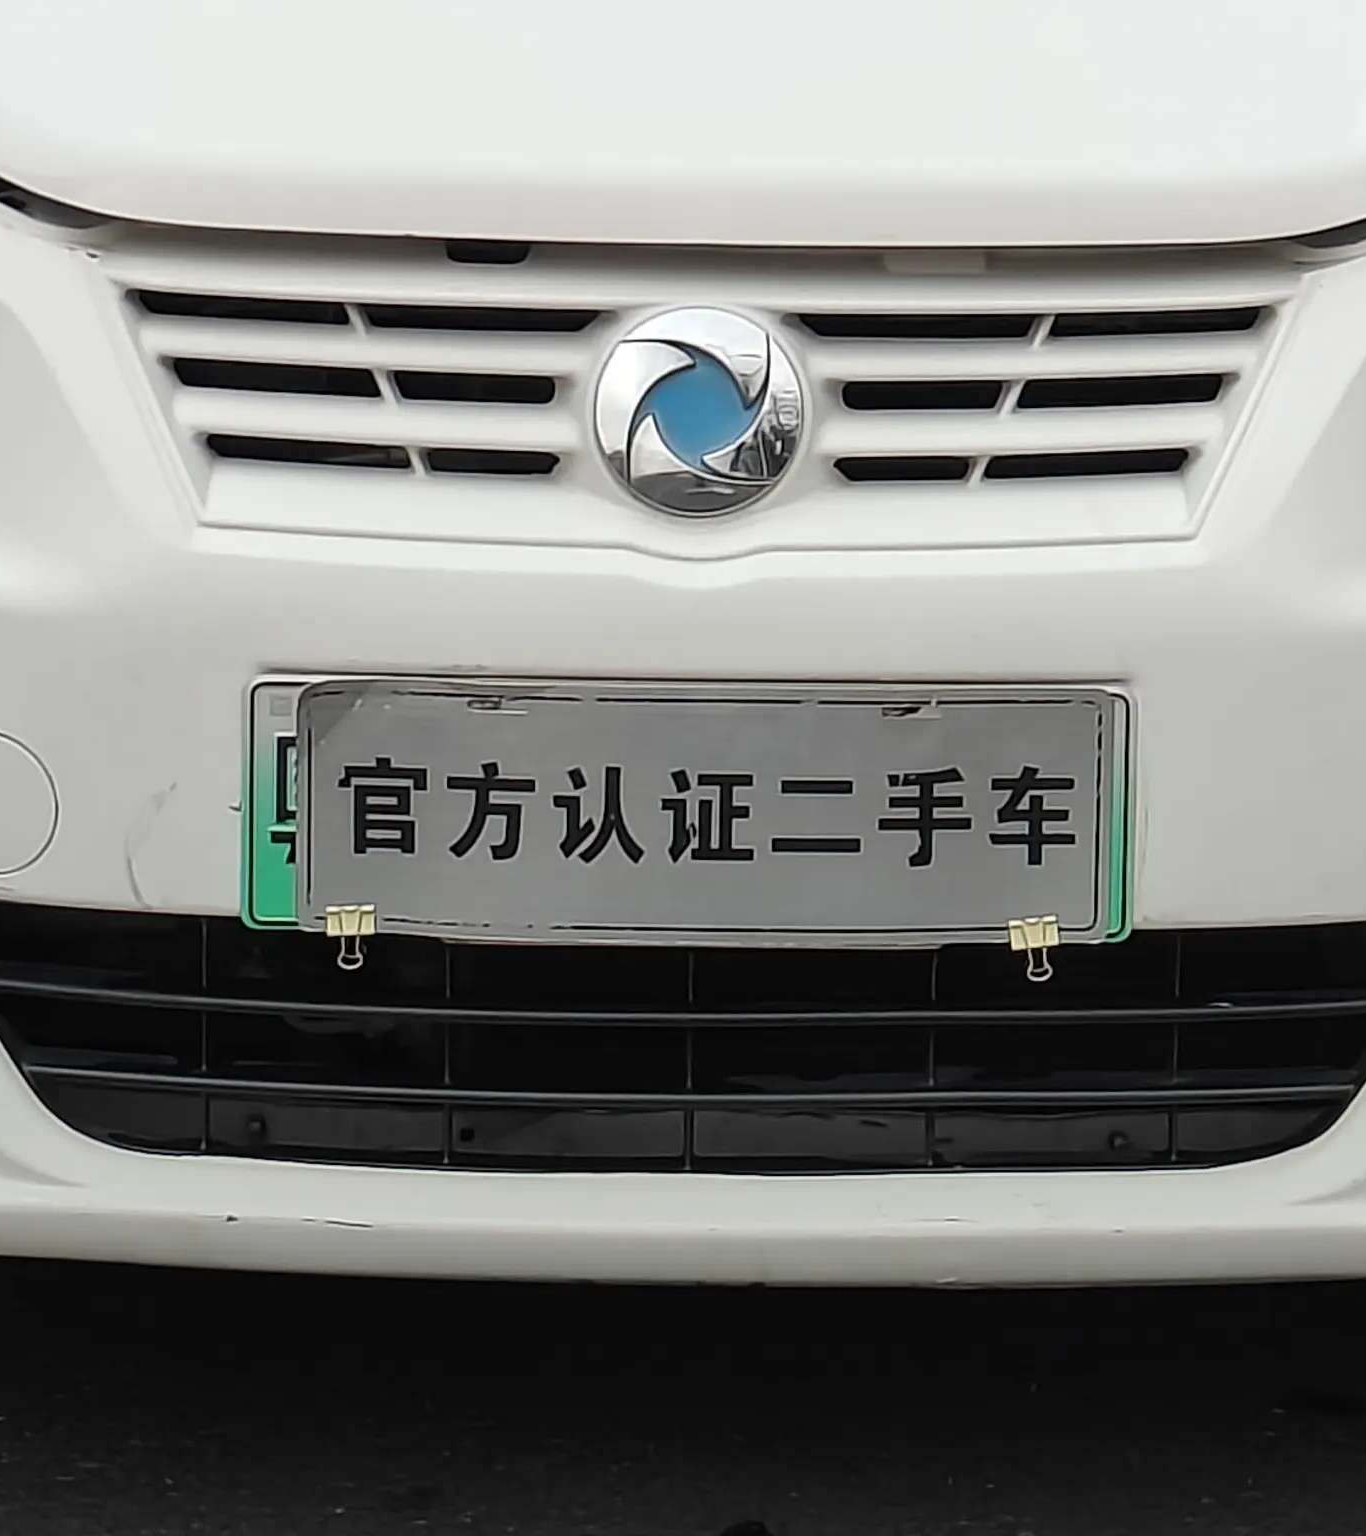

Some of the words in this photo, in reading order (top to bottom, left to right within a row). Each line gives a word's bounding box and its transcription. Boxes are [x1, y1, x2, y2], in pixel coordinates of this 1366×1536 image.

[337, 756, 1078, 868] 官方认证二手车
